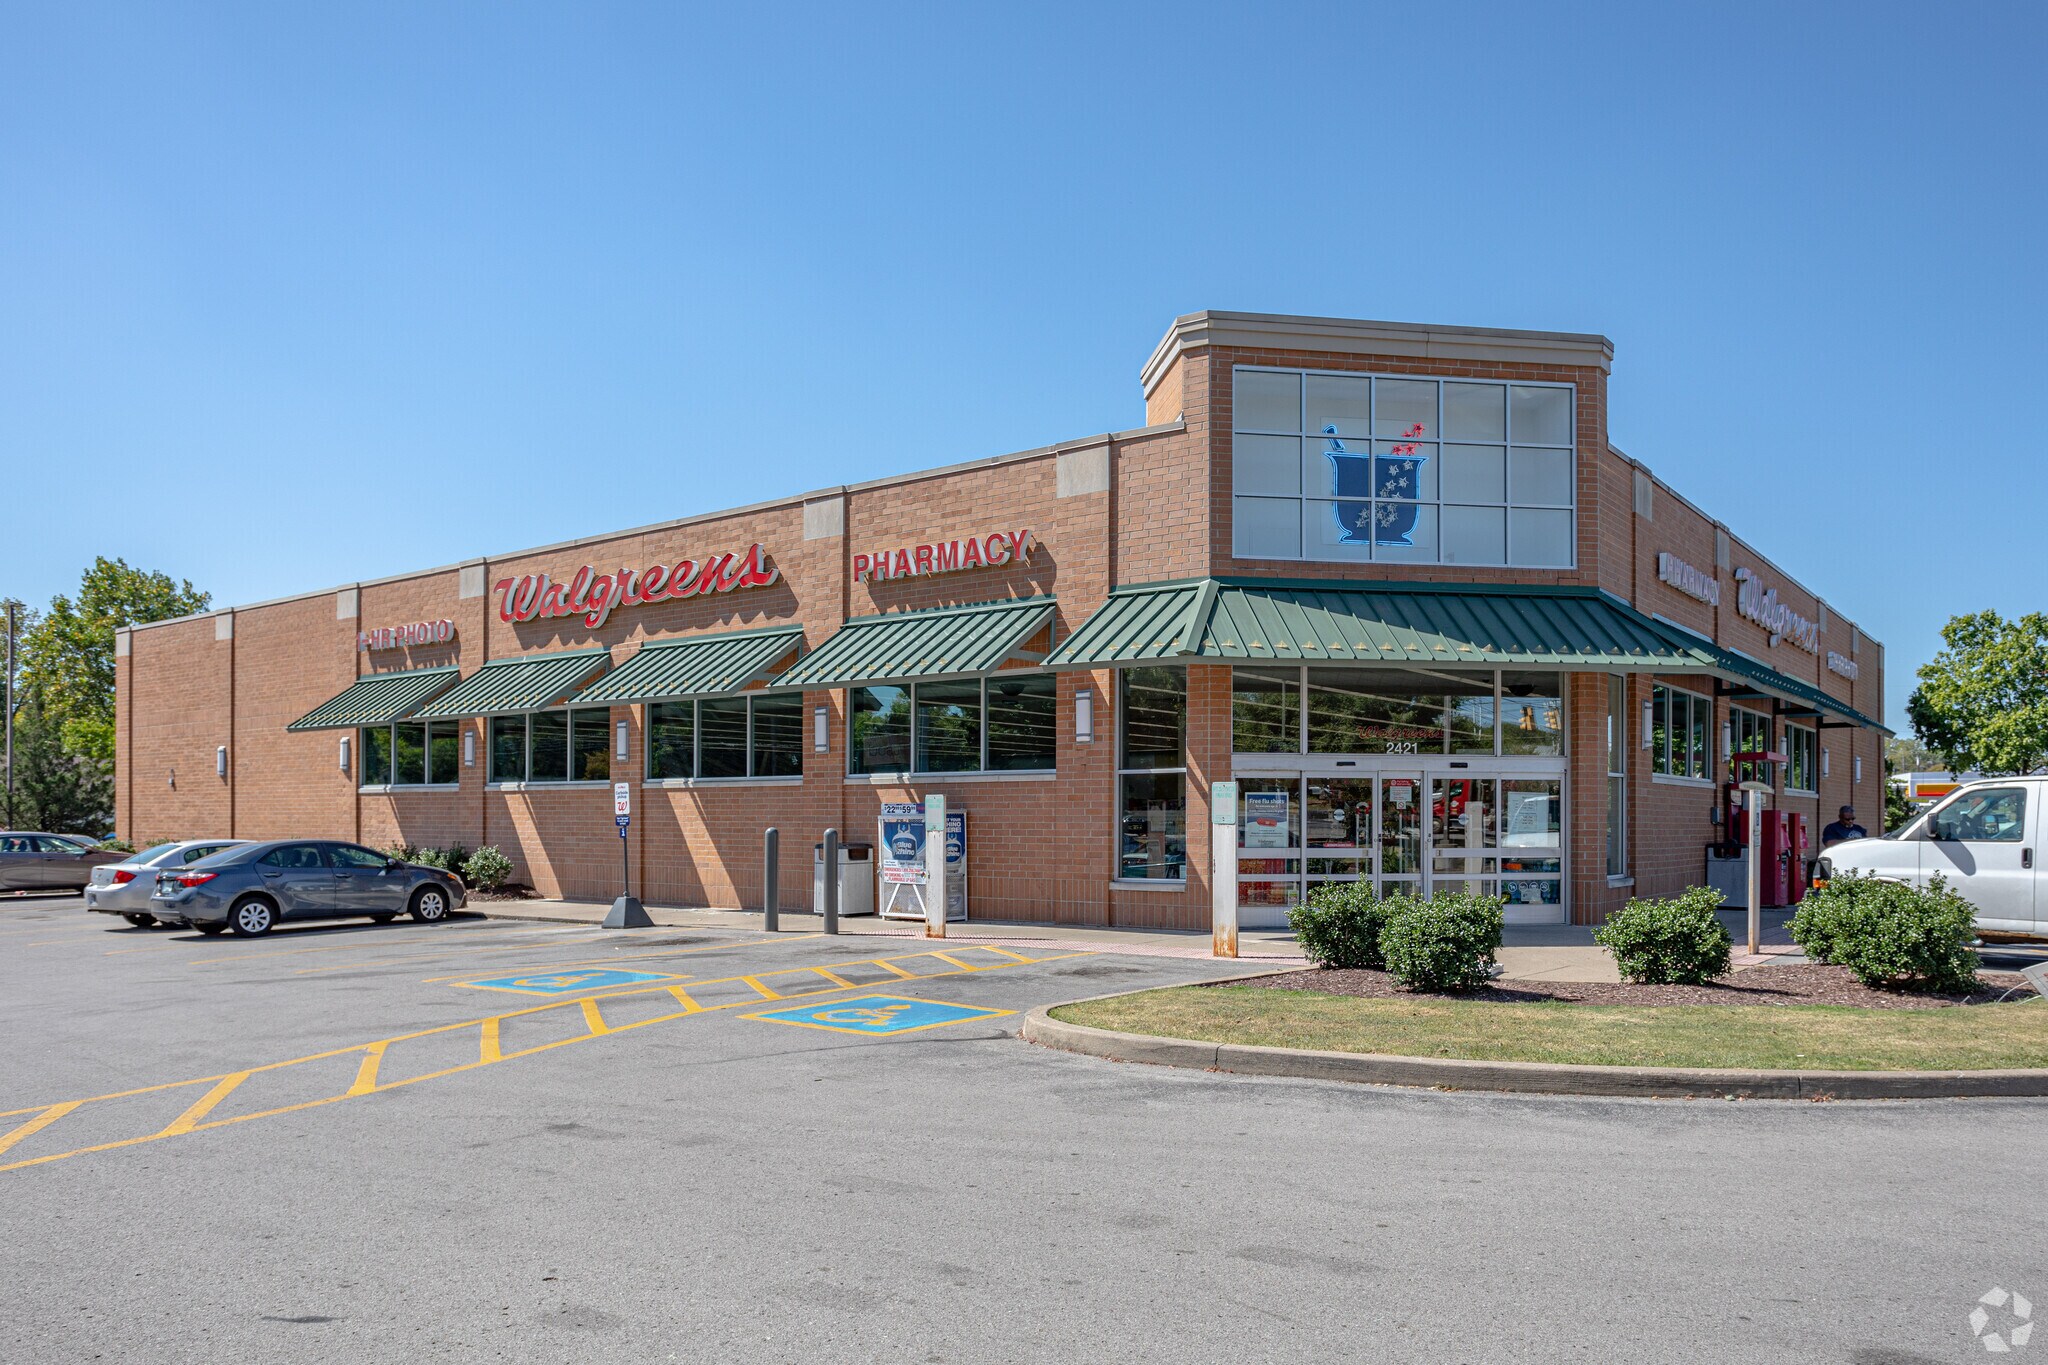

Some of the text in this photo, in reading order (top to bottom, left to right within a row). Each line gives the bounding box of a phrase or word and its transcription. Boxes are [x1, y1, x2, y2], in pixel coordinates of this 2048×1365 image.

[854, 529, 1032, 582] PHARMACY
[1661, 553, 1720, 606] PHARMACY
[494, 543, 779, 629] Walgreens
[1736, 567, 1819, 655] Walgreens
[396, 619, 454, 647] PHOTO
[1357, 725, 1444, 741] Walgreens
[1386, 742, 1418, 755] 2421
